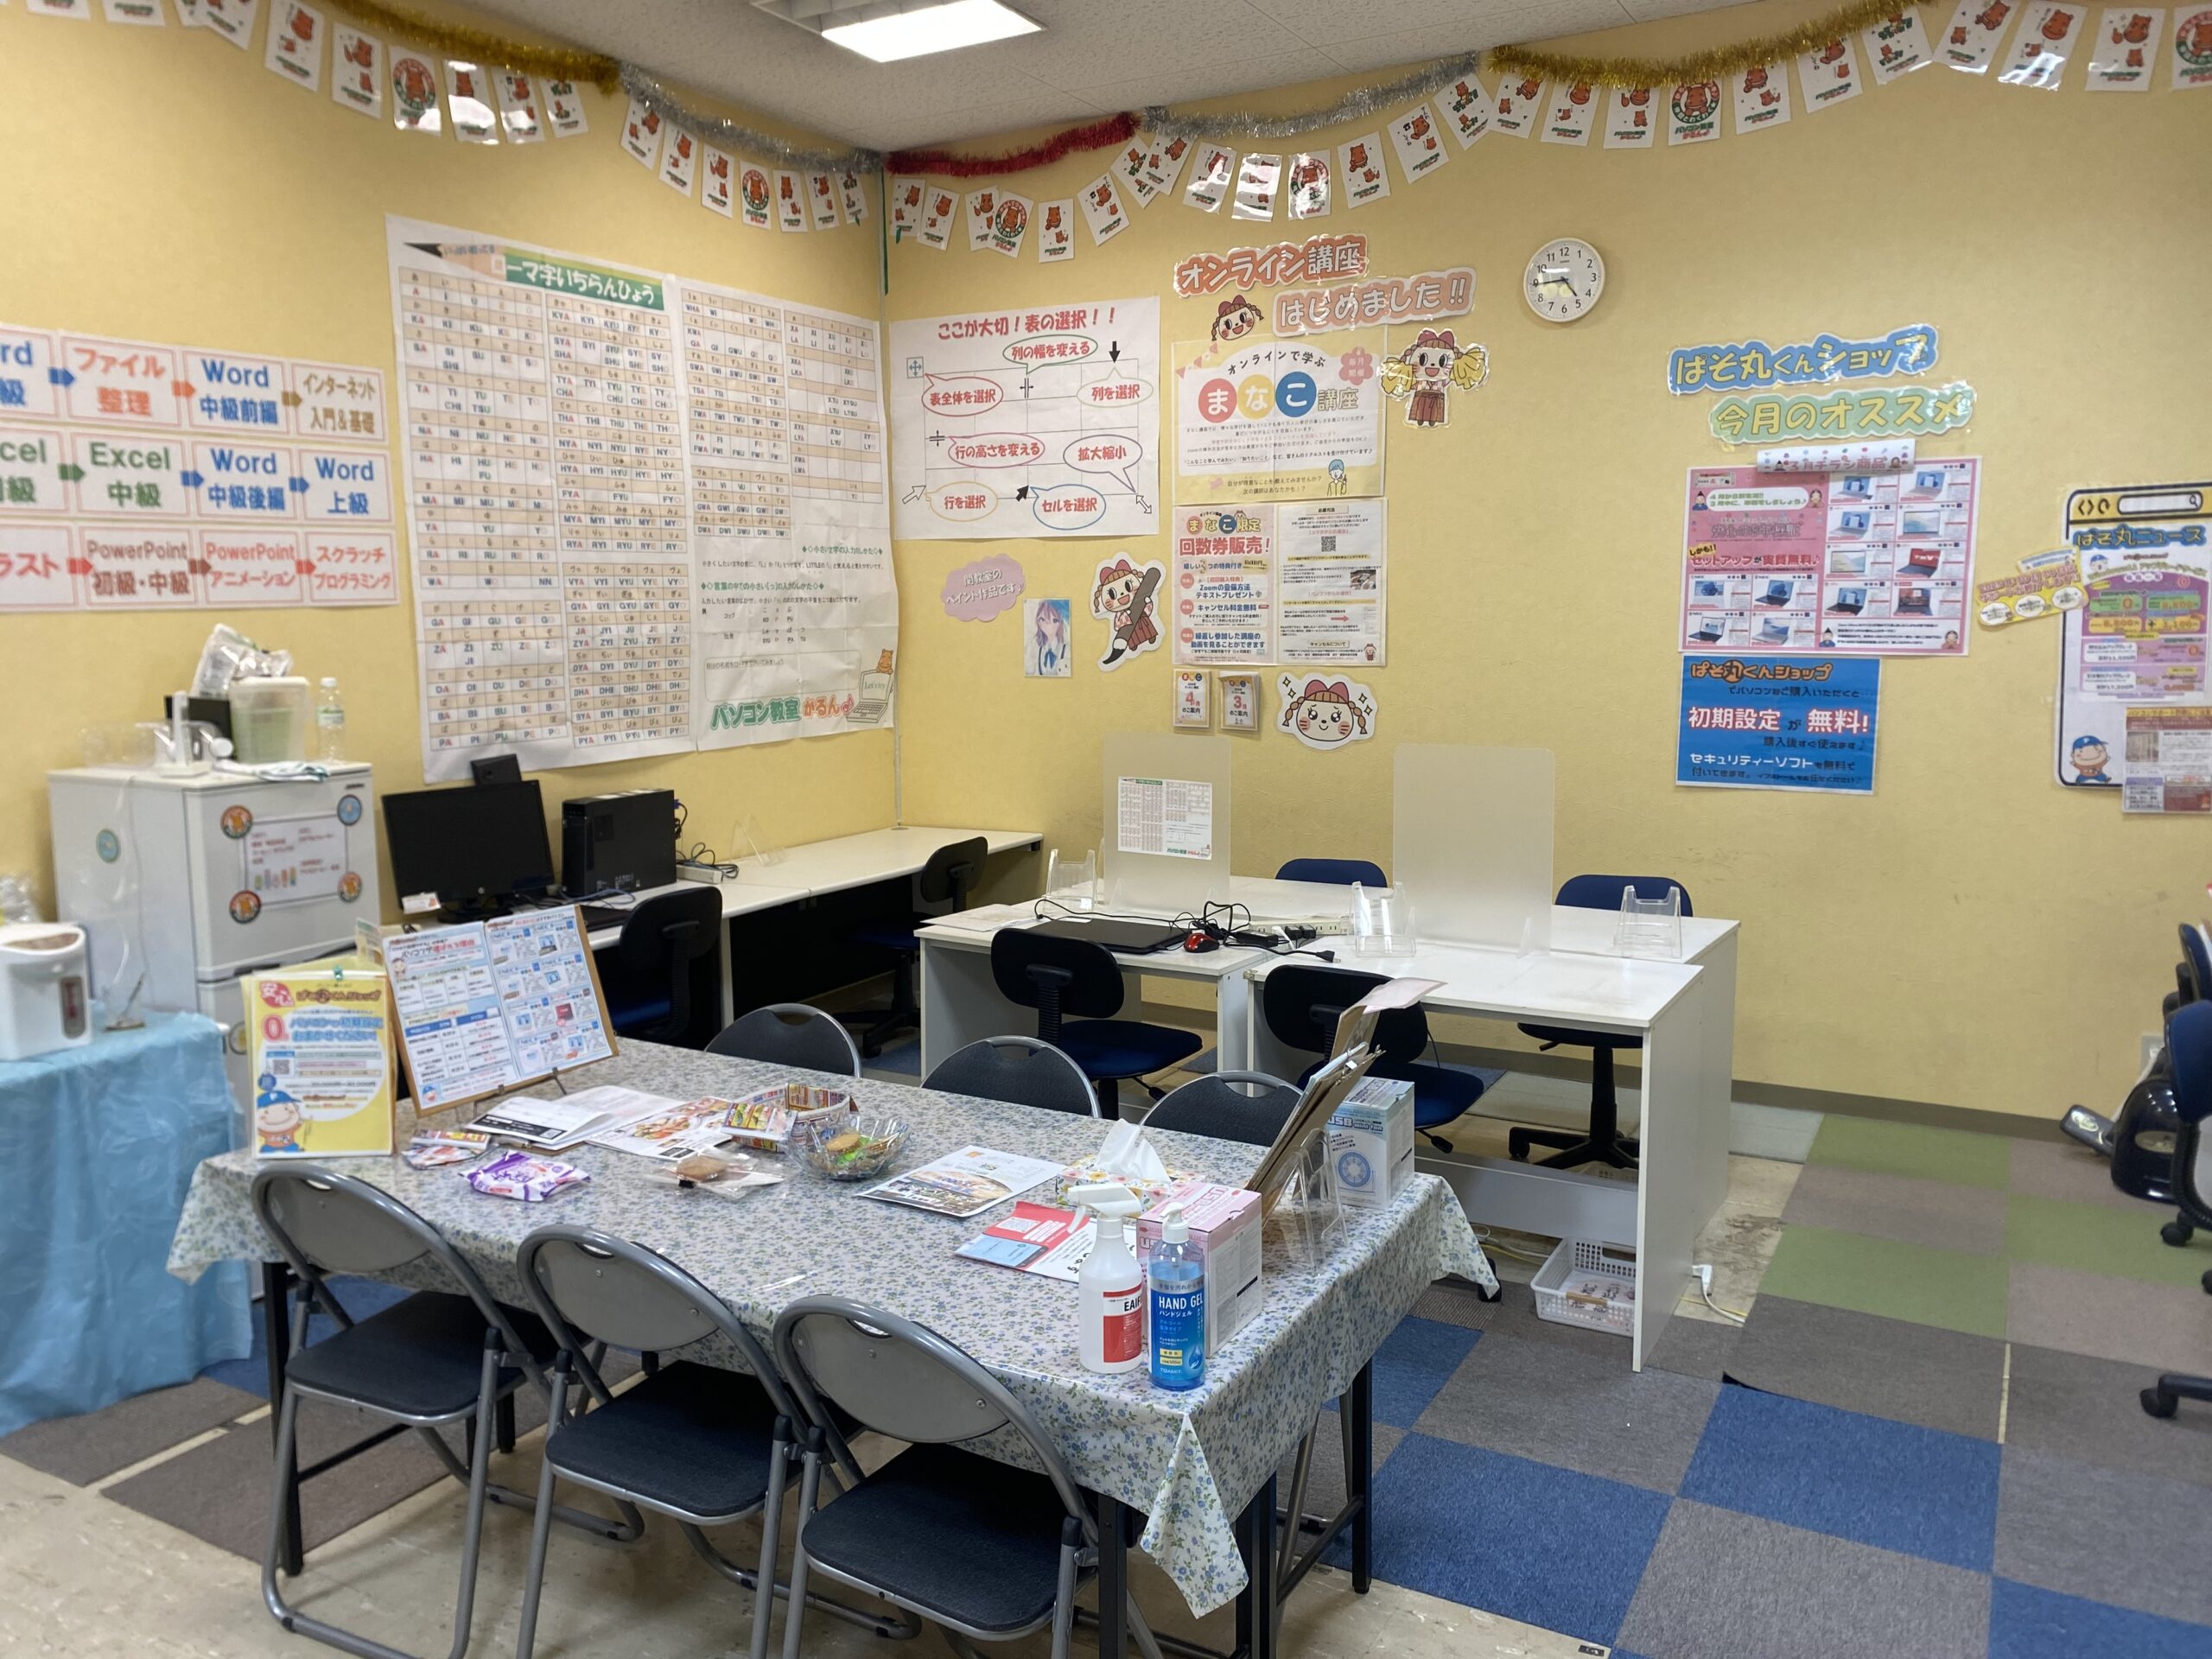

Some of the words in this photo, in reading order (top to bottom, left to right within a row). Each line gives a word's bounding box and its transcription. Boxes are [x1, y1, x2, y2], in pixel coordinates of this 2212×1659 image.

[1547, 253, 1555, 262] 11
[1560, 246, 1570, 257] 12
[1577, 250, 1581, 258] 1
[1181, 242, 1361, 289] オンライン講座
[1537, 264, 1547, 273] 10
[1587, 259, 1592, 268] 2
[1533, 279, 1539, 288] 9
[1591, 273, 1597, 282] 3
[1538, 294, 1543, 302] 8
[1586, 289, 1592, 297] 4
[1548, 302, 1554, 311] 7
[1561, 304, 1567, 314] 6
[1576, 300, 1581, 308] 5
[1011, 342, 1090, 360] 列の幅を変える
[73, 347, 165, 379] ファイル
[1228, 351, 1326, 375] オンラインで学ぶ
[1676, 335, 1928, 385] ぱそ丸くんショップ
[200, 359, 270, 389] Word
[302, 372, 377, 401] インターネット
[1091, 384, 1140, 400] 列を選択
[97, 387, 152, 417] 整理
[199, 396, 279, 425] 中級前編
[930, 389, 995, 406] 表全体を選択
[1717, 392, 1962, 435] 今月のオススメ
[955, 442, 1039, 459] 行の高さを変える
[1077, 445, 1127, 461] 拡大縮小
[90, 441, 172, 472] Excel
[210, 448, 278, 476] Word
[315, 456, 375, 482] Word
[107, 481, 162, 509] 中級
[207, 485, 286, 512] 中級後編
[327, 492, 370, 516] 上級
[944, 495, 986, 510] 行を選択
[1041, 495, 1097, 512] セルを選択
[87, 540, 188, 560] PowerPoint
[206, 542, 296, 562] PowerPoint
[315, 546, 386, 564] スクラッチ
[210, 572, 297, 589] アニメーション
[314, 572, 391, 591] プログラミング
[1691, 660, 1833, 683] ぱそ丸くんショップ
[711, 696, 802, 730] パソコン教室
[1688, 708, 1781, 730] 初期設定
[1787, 720, 1802, 731] が
[1159, 1296, 1187, 1310] HAND
[1191, 1293, 1204, 1308] GEL
